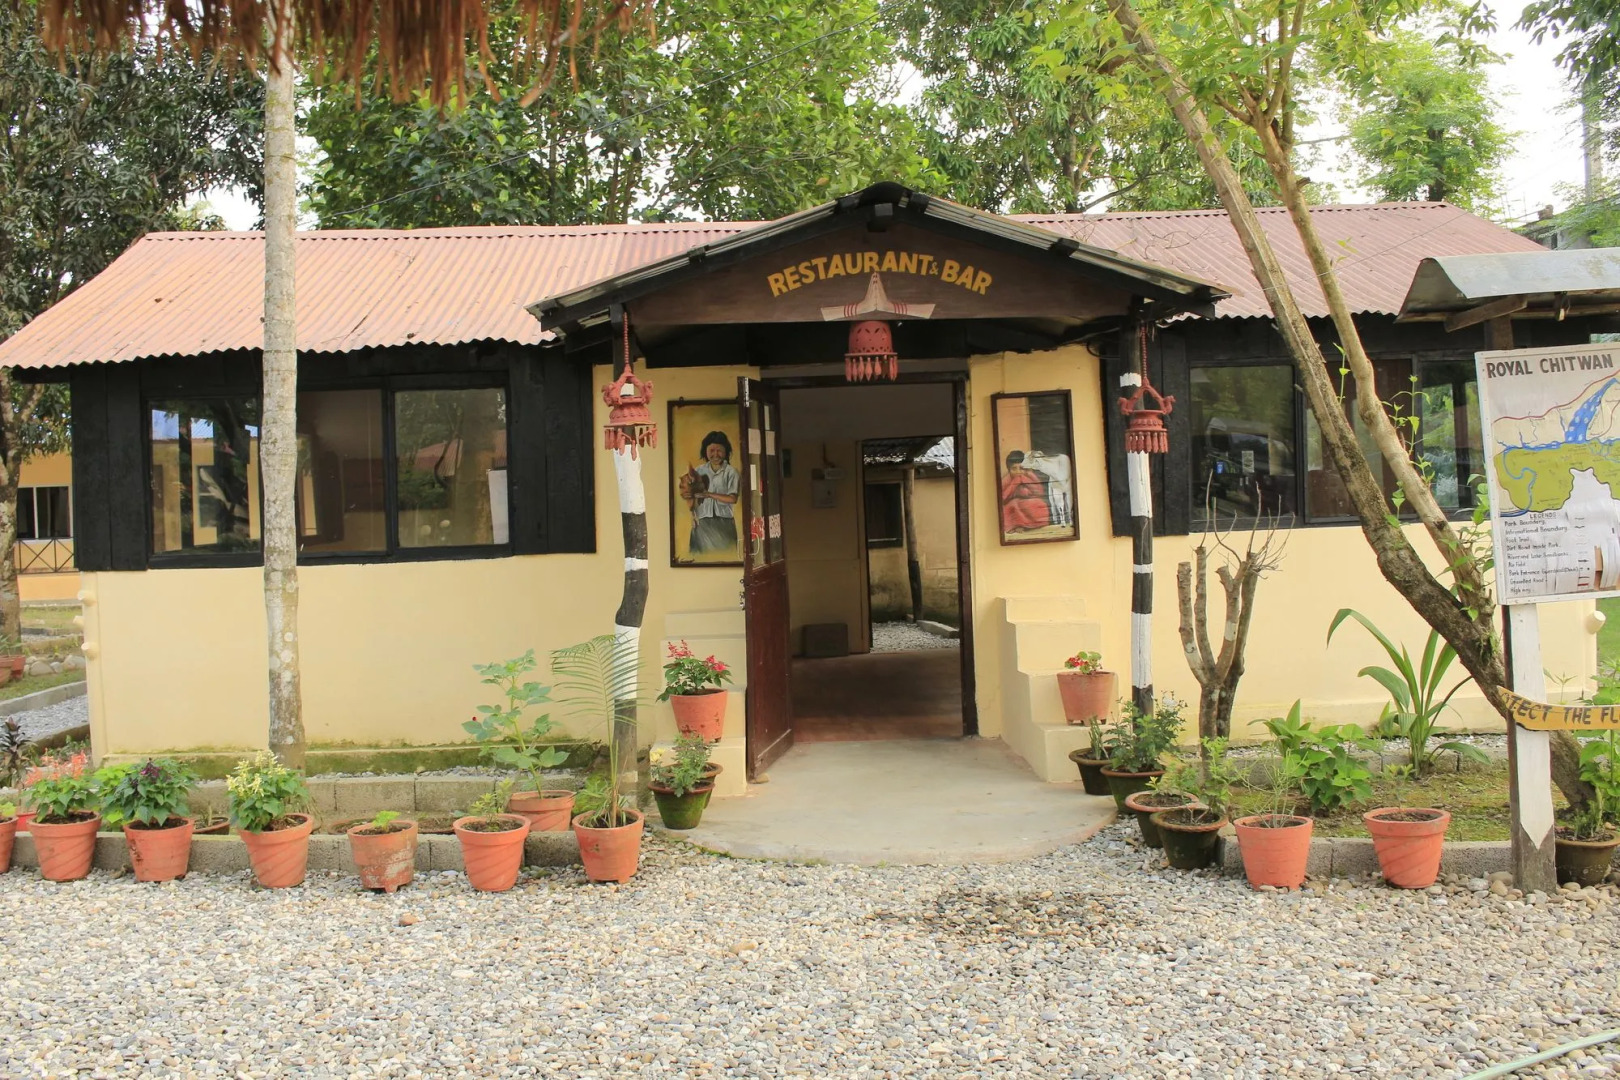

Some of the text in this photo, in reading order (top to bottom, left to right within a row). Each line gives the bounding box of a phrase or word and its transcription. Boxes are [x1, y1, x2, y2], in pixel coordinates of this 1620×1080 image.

[766, 251, 993, 297] RESTAURANT & BAR
[1486, 354, 1614, 378] ROYAL CHITWAN
[1564, 706, 1592, 725] THE
[1600, 706, 1620, 724] FL
